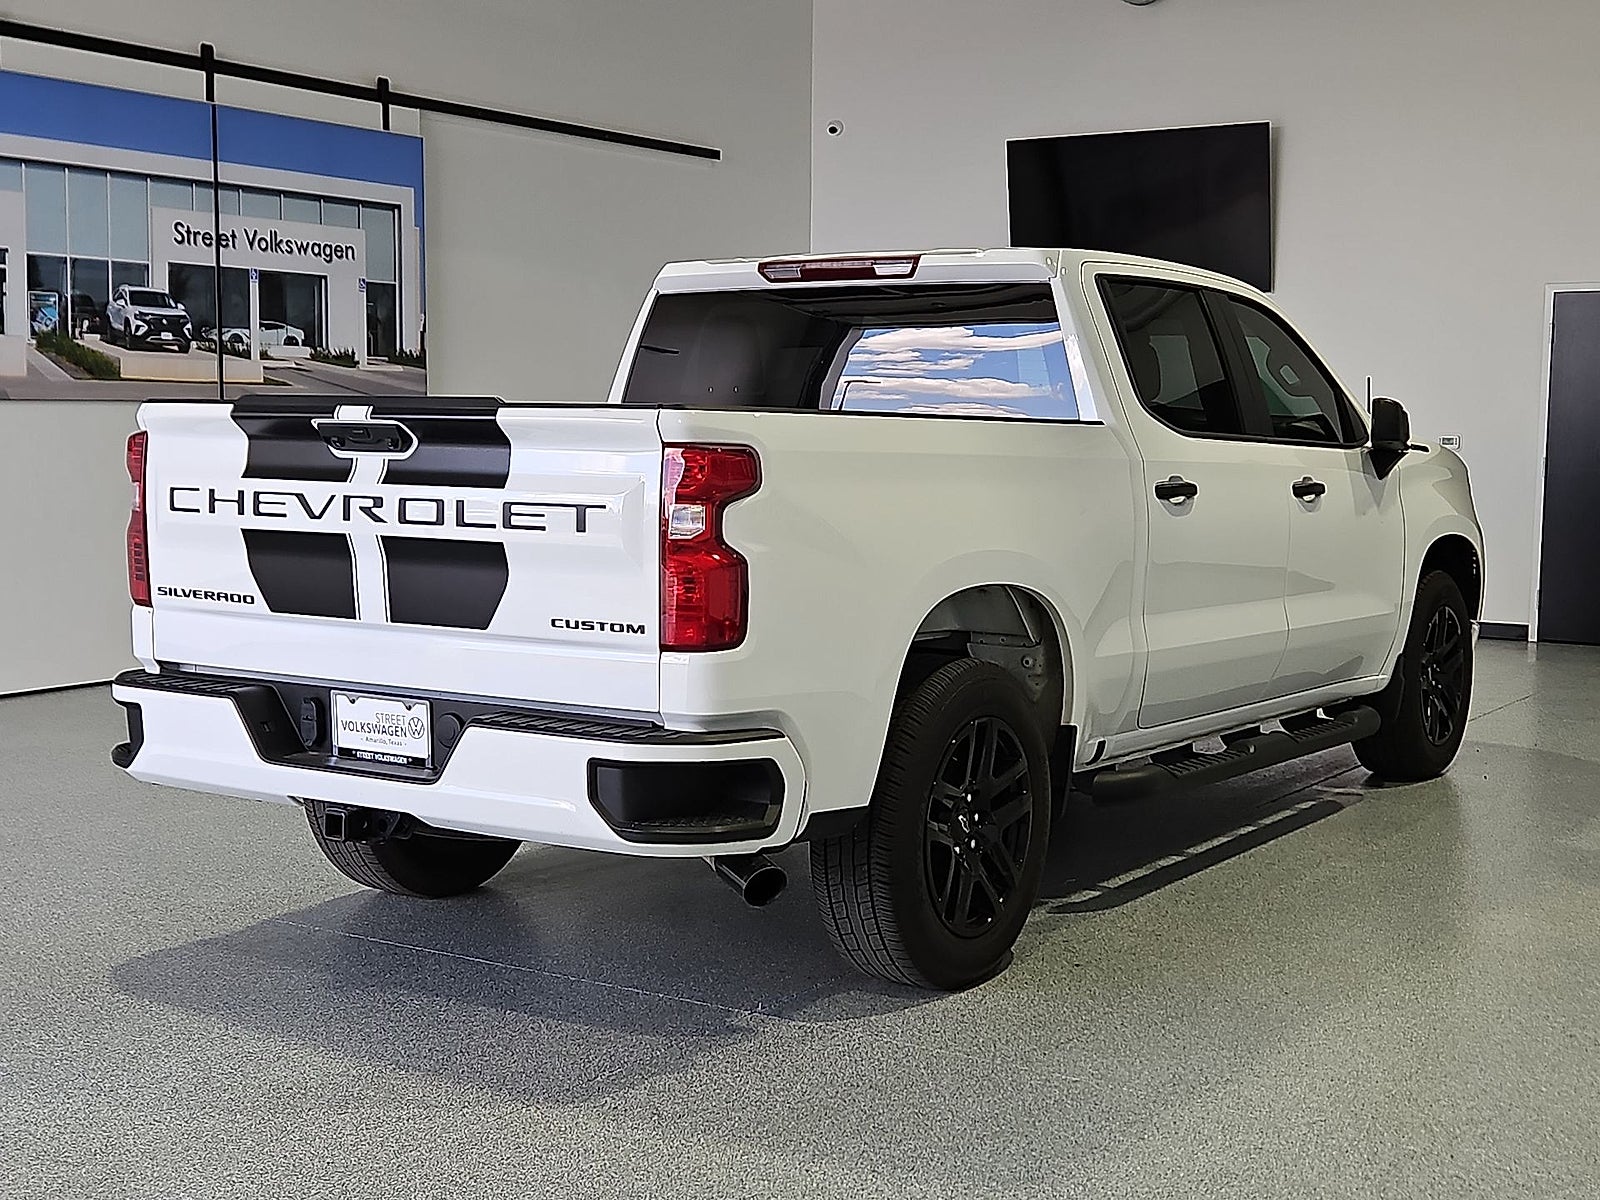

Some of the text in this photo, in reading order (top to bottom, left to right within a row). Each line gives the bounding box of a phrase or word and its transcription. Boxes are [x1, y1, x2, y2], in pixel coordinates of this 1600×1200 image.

[173, 221, 356, 264] Street Volkswagen
[169, 486, 606, 533] CHEVROLET
[157, 586, 255, 605] SILVERADO
[551, 618, 646, 635] CUSTOM
[341, 719, 407, 738] VOLKSWAGEN
[375, 712, 406, 726] STREET
